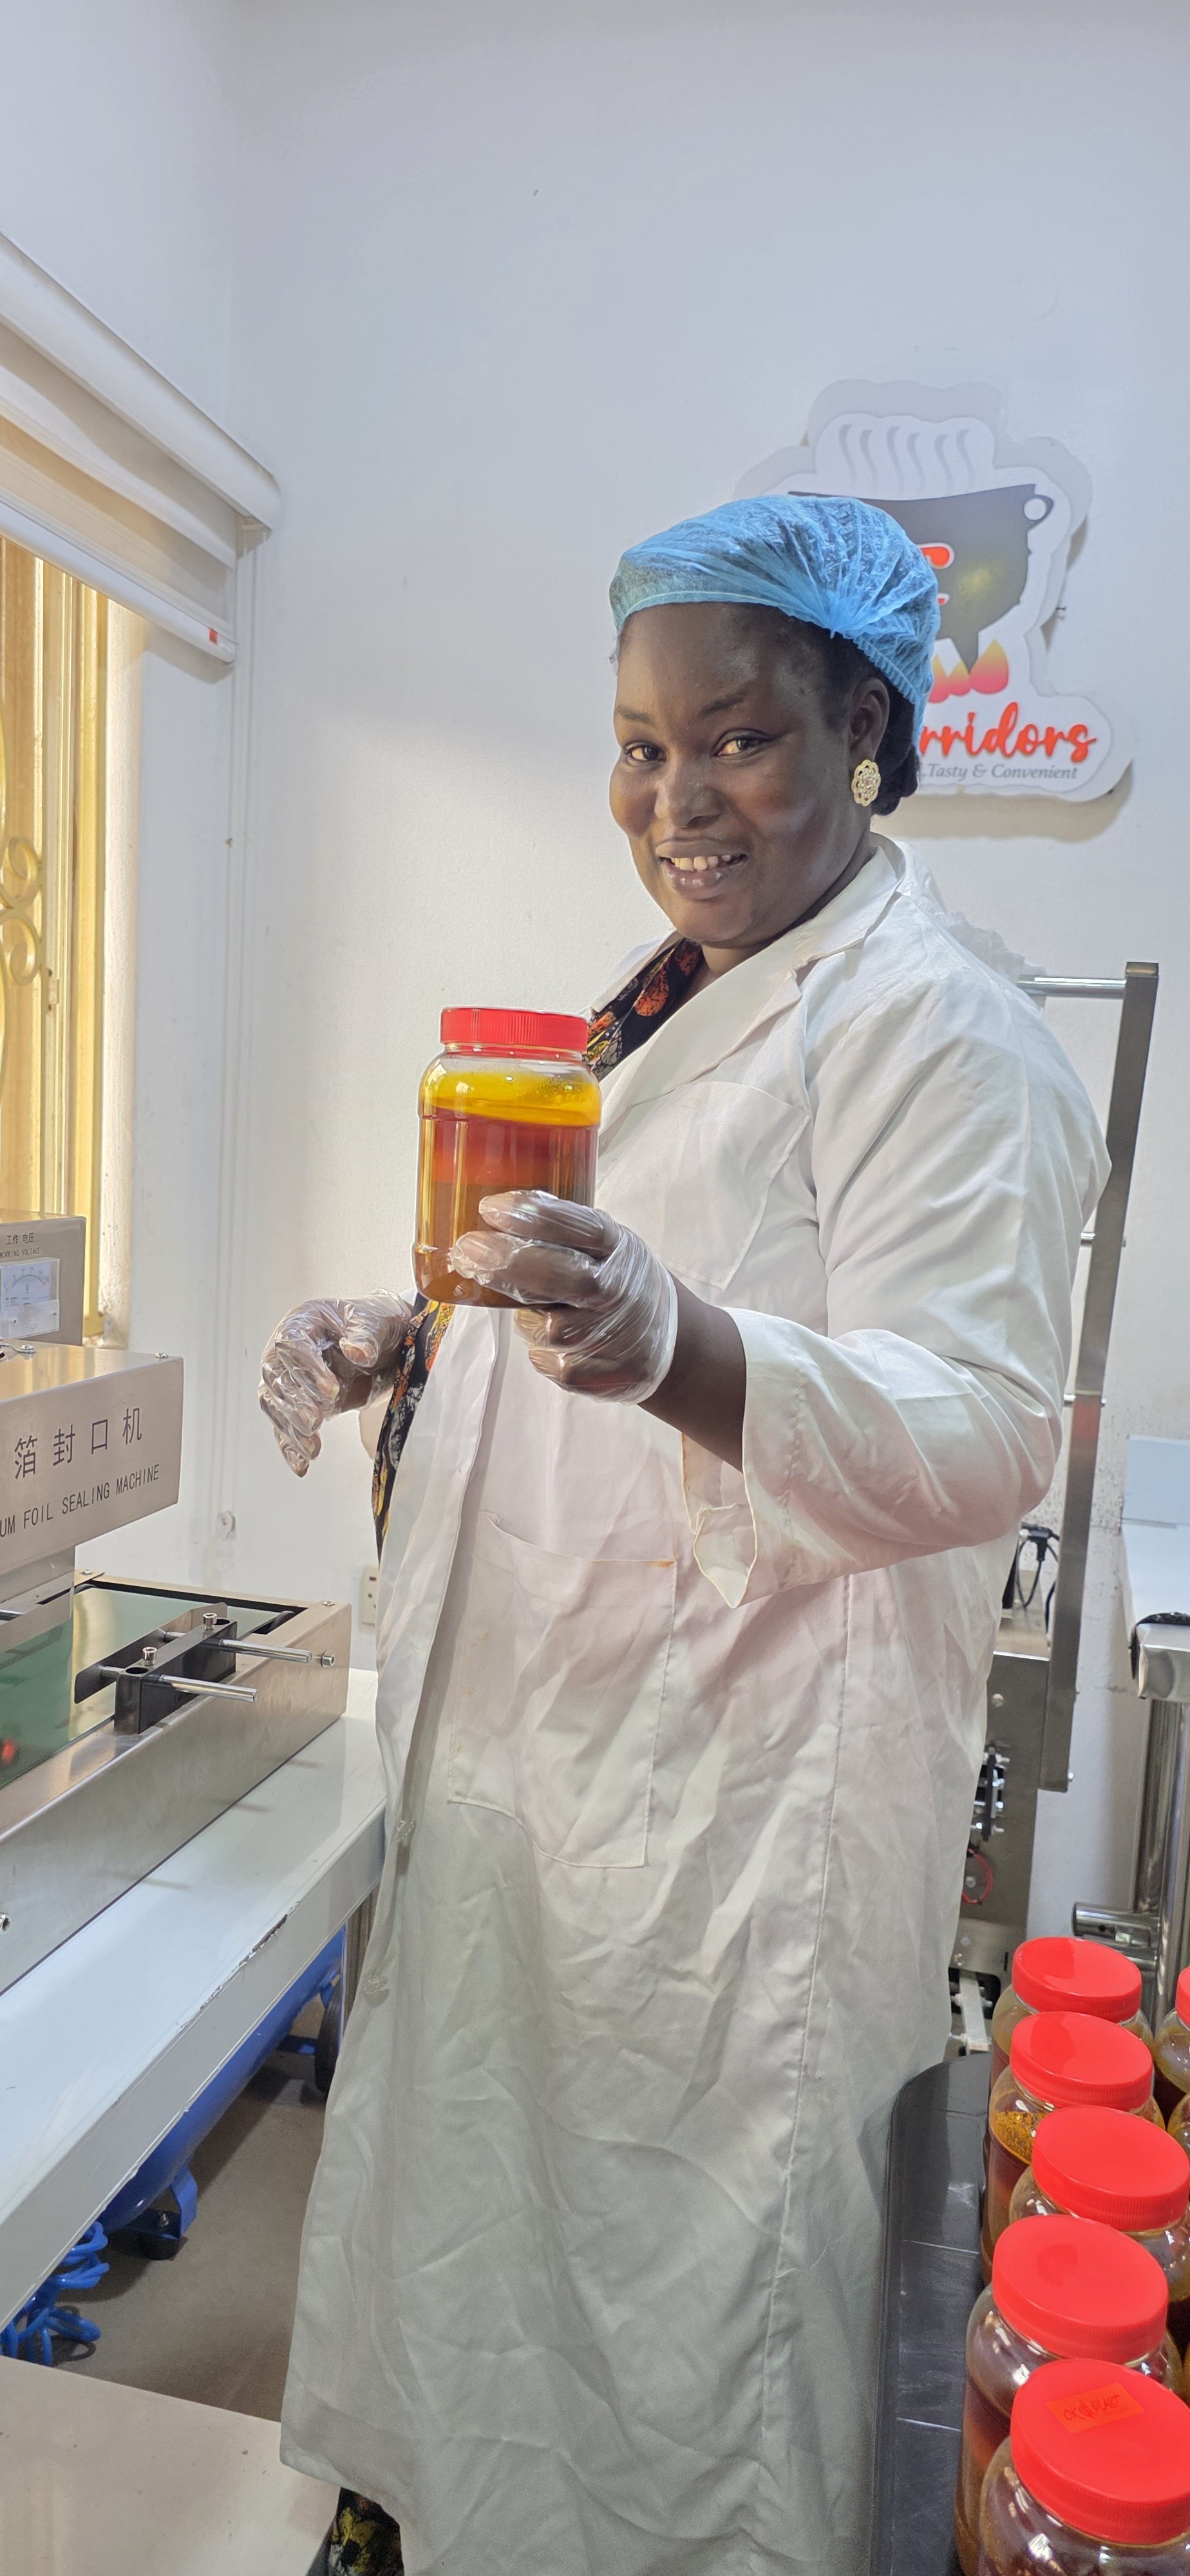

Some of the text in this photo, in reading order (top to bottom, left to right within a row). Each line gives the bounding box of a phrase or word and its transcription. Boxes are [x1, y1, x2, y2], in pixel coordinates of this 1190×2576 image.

[972, 764, 987, 778] &
[991, 764, 1078, 779] Convenient
[14, 1407, 142, 1480] 箔封口机
[23, 1502, 53, 1530] FOIL
[62, 1482, 110, 1515] SEALING
[115, 1464, 160, 1495] MACHINE
